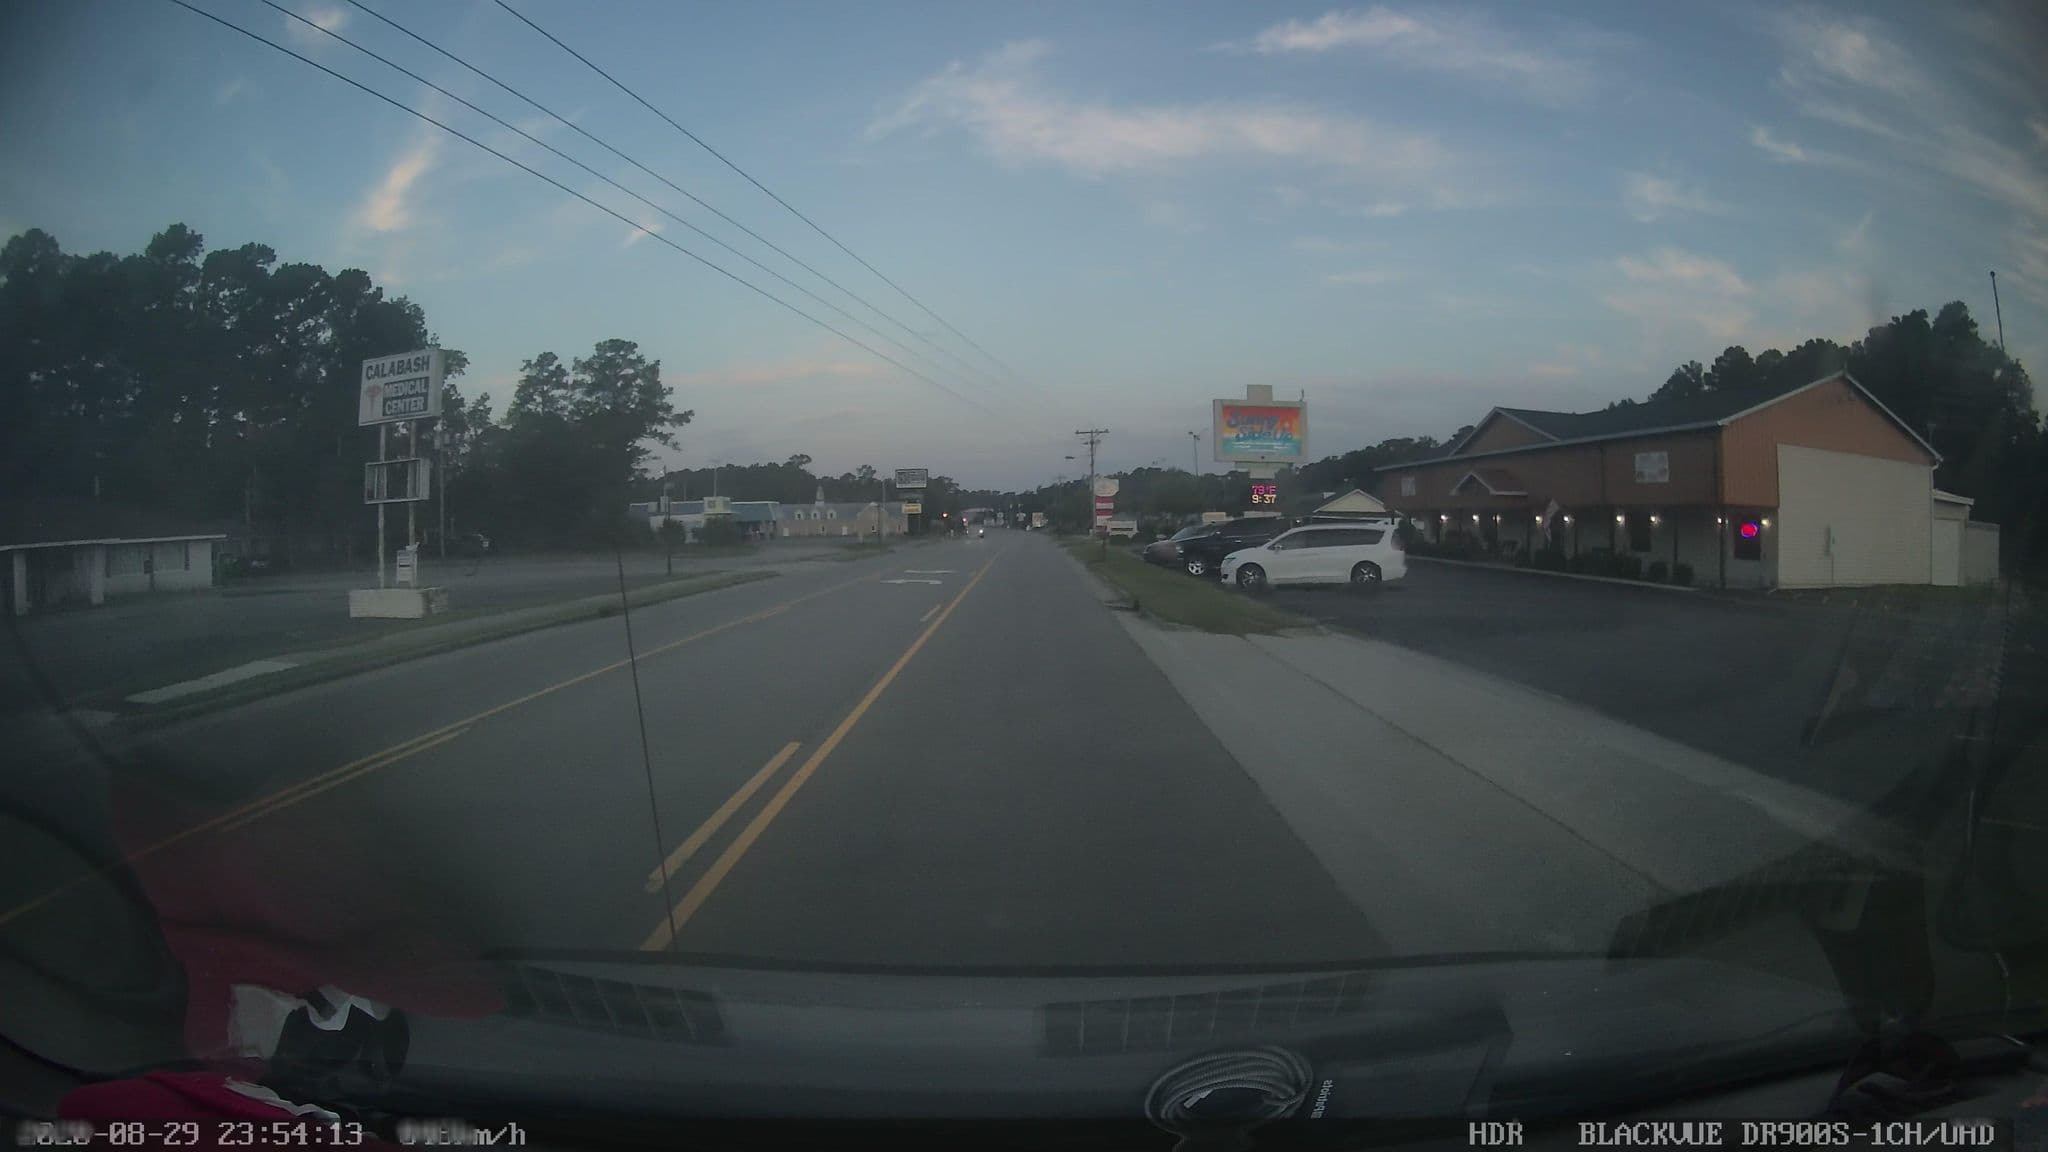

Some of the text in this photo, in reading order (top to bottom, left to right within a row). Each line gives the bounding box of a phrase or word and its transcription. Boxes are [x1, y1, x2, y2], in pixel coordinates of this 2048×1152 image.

[366, 354, 430, 380] CALABASH
[383, 378, 428, 398] MEDICAL
[384, 396, 425, 415] CENTER
[1252, 494, 1277, 504] 9:37
